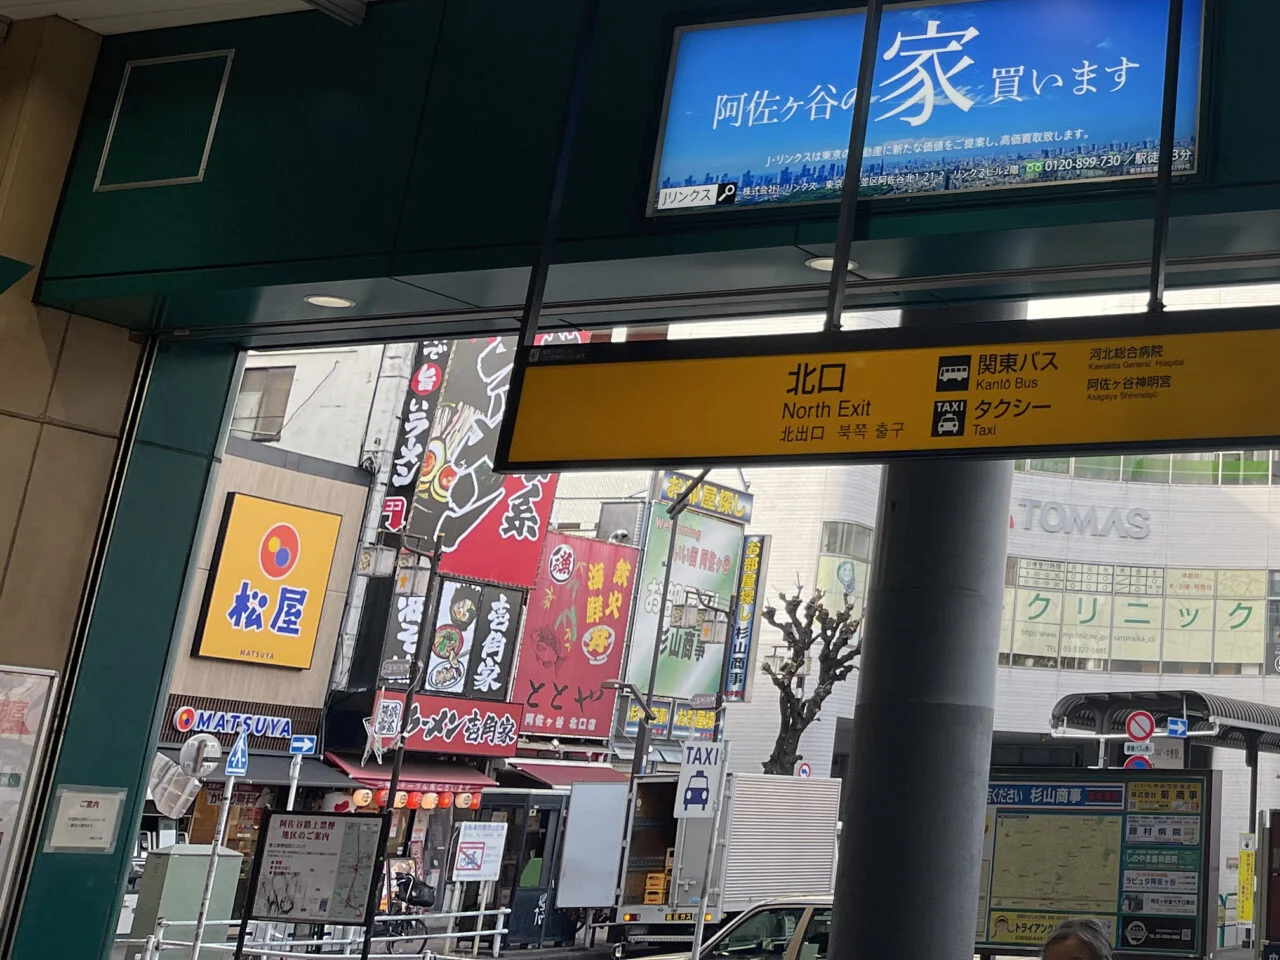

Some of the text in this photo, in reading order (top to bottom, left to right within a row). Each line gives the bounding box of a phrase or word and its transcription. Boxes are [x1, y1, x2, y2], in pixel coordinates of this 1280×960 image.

[766, 128, 1089, 168] J-リンクスは東京の動産に新たな価値をご提案し、高価買取致します。
[1045, 154, 1121, 172] 0120-899-730
[1088, 345, 1164, 361] 河北総合病院
[976, 351, 1059, 376] 関東バス
[785, 361, 847, 397] 北口
[1014, 376, 1039, 390] Bus
[781, 399, 872, 420] North Exit
[936, 401, 966, 413] TAXI
[974, 398, 1052, 420] タクシー
[780, 424, 825, 443] 北出口
[972, 423, 997, 438] Taxi
[1019, 498, 1151, 540] TOMAS
[227, 580, 308, 637] 松屋
[728, 541, 761, 687] お部屋探し 杉山商事
[239, 649, 275, 660] MATSUYA
[196, 709, 292, 738] MATSUYA
[686, 746, 720, 766] TAXI
[1030, 787, 1082, 805] 杉山商事
